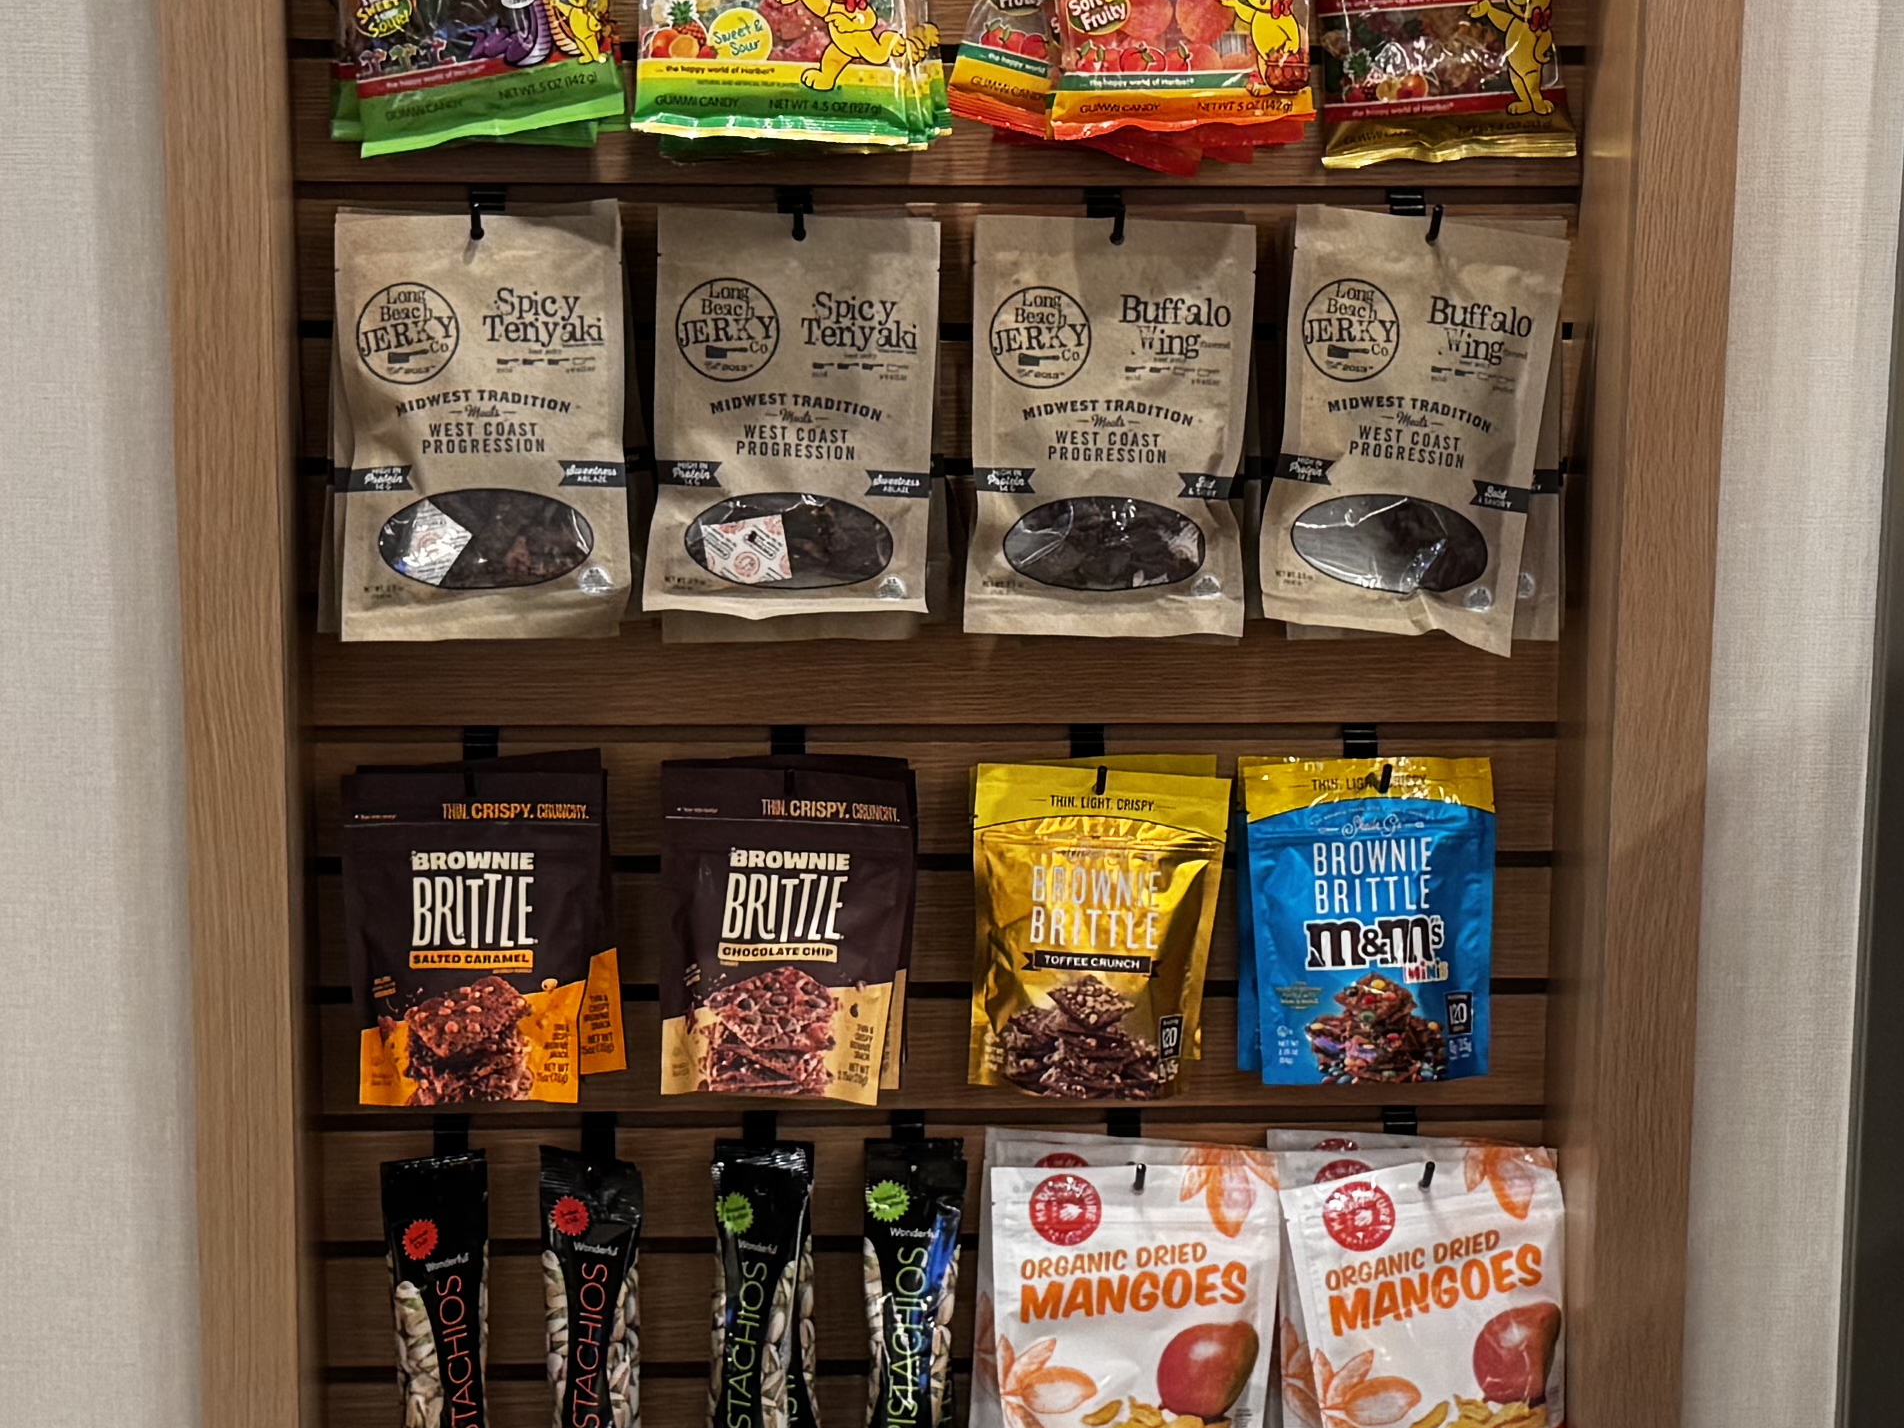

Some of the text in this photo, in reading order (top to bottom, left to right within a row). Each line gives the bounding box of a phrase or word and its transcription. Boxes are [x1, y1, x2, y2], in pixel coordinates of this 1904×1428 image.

[1068, 0, 1099, 18] Soft
[1081, 0, 1129, 34] Fruity
[380, 303, 433, 322] Beach
[385, 288, 426, 306] Long
[497, 288, 581, 325] Spicy
[1120, 294, 1231, 328] Buffalo
[359, 313, 455, 356] JERKY
[483, 317, 604, 352] Teriyaki
[1430, 296, 1533, 339] Buffalo
[993, 322, 1088, 355] JERKY
[396, 390, 571, 417] MIDWEST TRADITION
[422, 438, 545, 455] PROGRESSION
[429, 421, 538, 439] WEST COAST
[411, 851, 534, 871] BROWNIE
[730, 847, 850, 872] BROWNIE
[1314, 838, 1432, 876] BROWNIE
[1031, 866, 1159, 910] BROWNIE
[1315, 875, 1431, 914] BRITTLE
[412, 876, 538, 947] BRITTLE
[722, 873, 848, 942] BRITTLE
[1030, 909, 1159, 950] BRITTLE
[412, 952, 530, 964] SALTED CARAMEL
[722, 946, 834, 958] CHOCOLATE CHIP
[1044, 956, 1140, 970] TOFFEE CRUNCH
[889, 1226, 940, 1239] Wonderful
[1021, 1242, 1206, 1280] ORGANIC DRIED
[1325, 1230, 1500, 1292] ORGANIC DRIED
[1020, 1261, 1247, 1322] MANGOES
[1328, 1244, 1542, 1336] MANGOES
